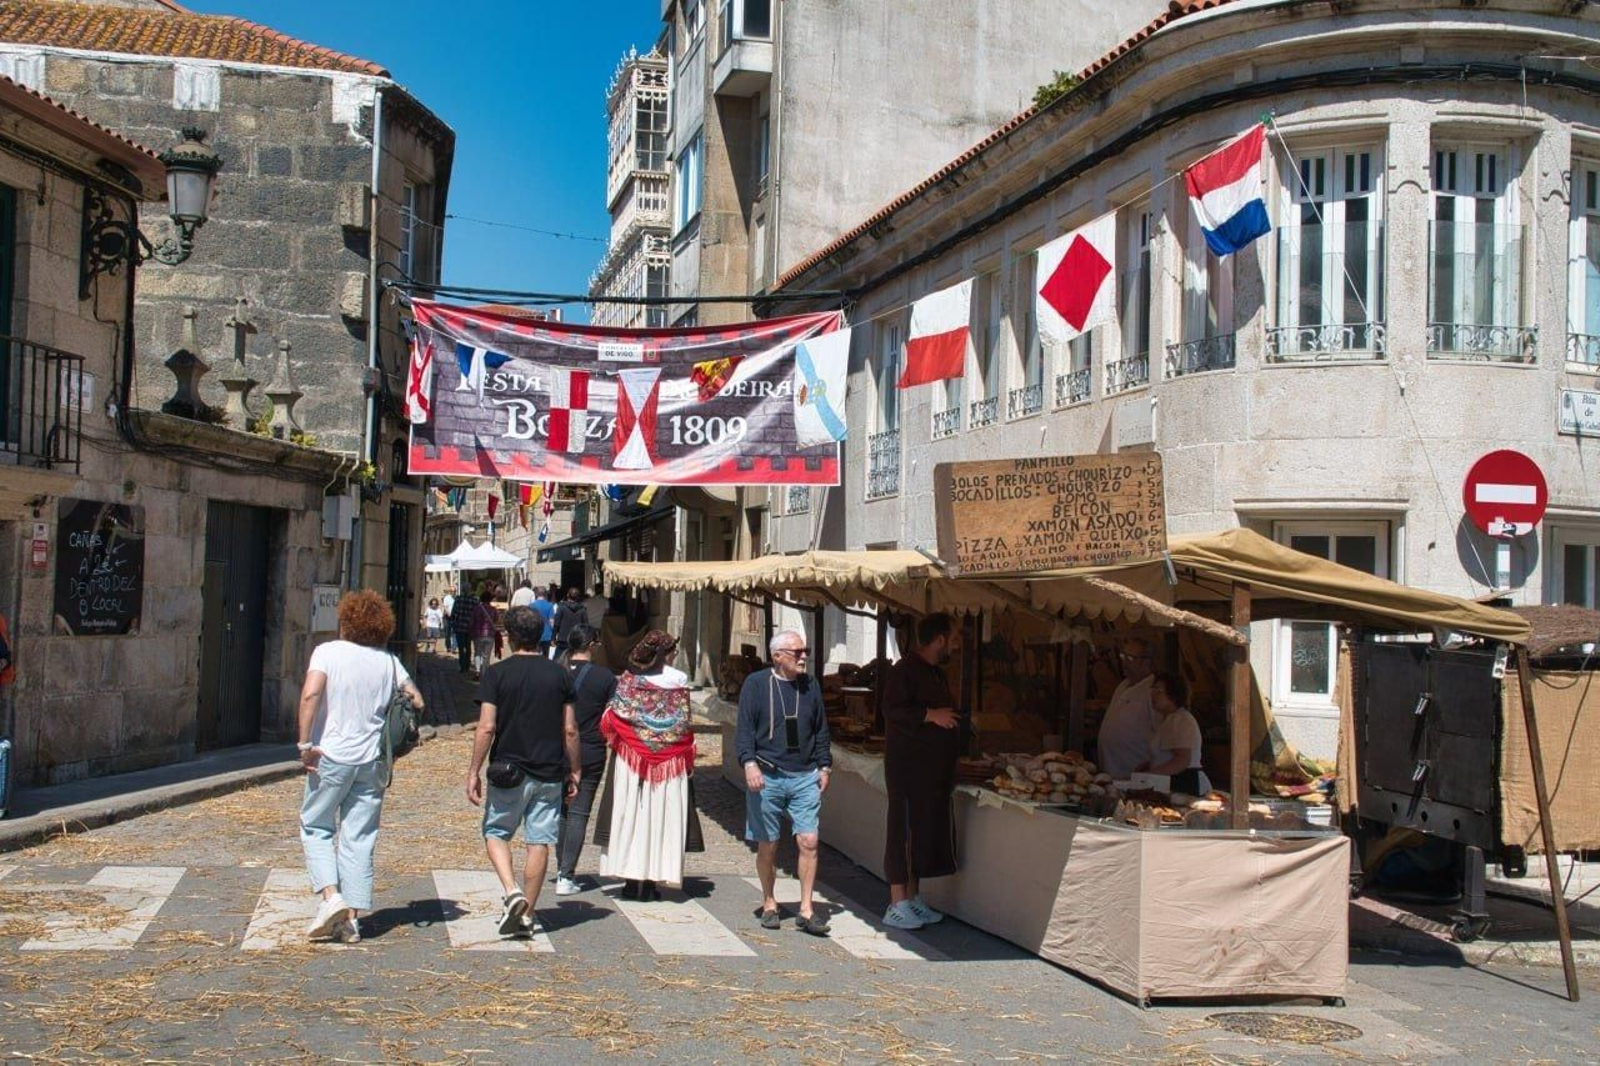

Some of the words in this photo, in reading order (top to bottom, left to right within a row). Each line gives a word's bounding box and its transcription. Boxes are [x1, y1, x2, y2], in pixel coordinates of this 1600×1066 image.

[1585, 407, 1594, 416] de
[670, 415, 748, 445] 1809
[1047, 480, 1121, 495] CHOURIZO
[1057, 491, 1097, 505] LOMO
[1052, 501, 1111, 519] BEICON
[1028, 517, 1080, 533] XAMON
[1085, 511, 1137, 531] ASADO
[69, 530, 104, 548] CAÑAS
[1023, 530, 1075, 548] XAMON
[1089, 527, 1143, 542] QUEIXO
[1029, 544, 1066, 556] LOMO
[80, 557, 88, 575] A
